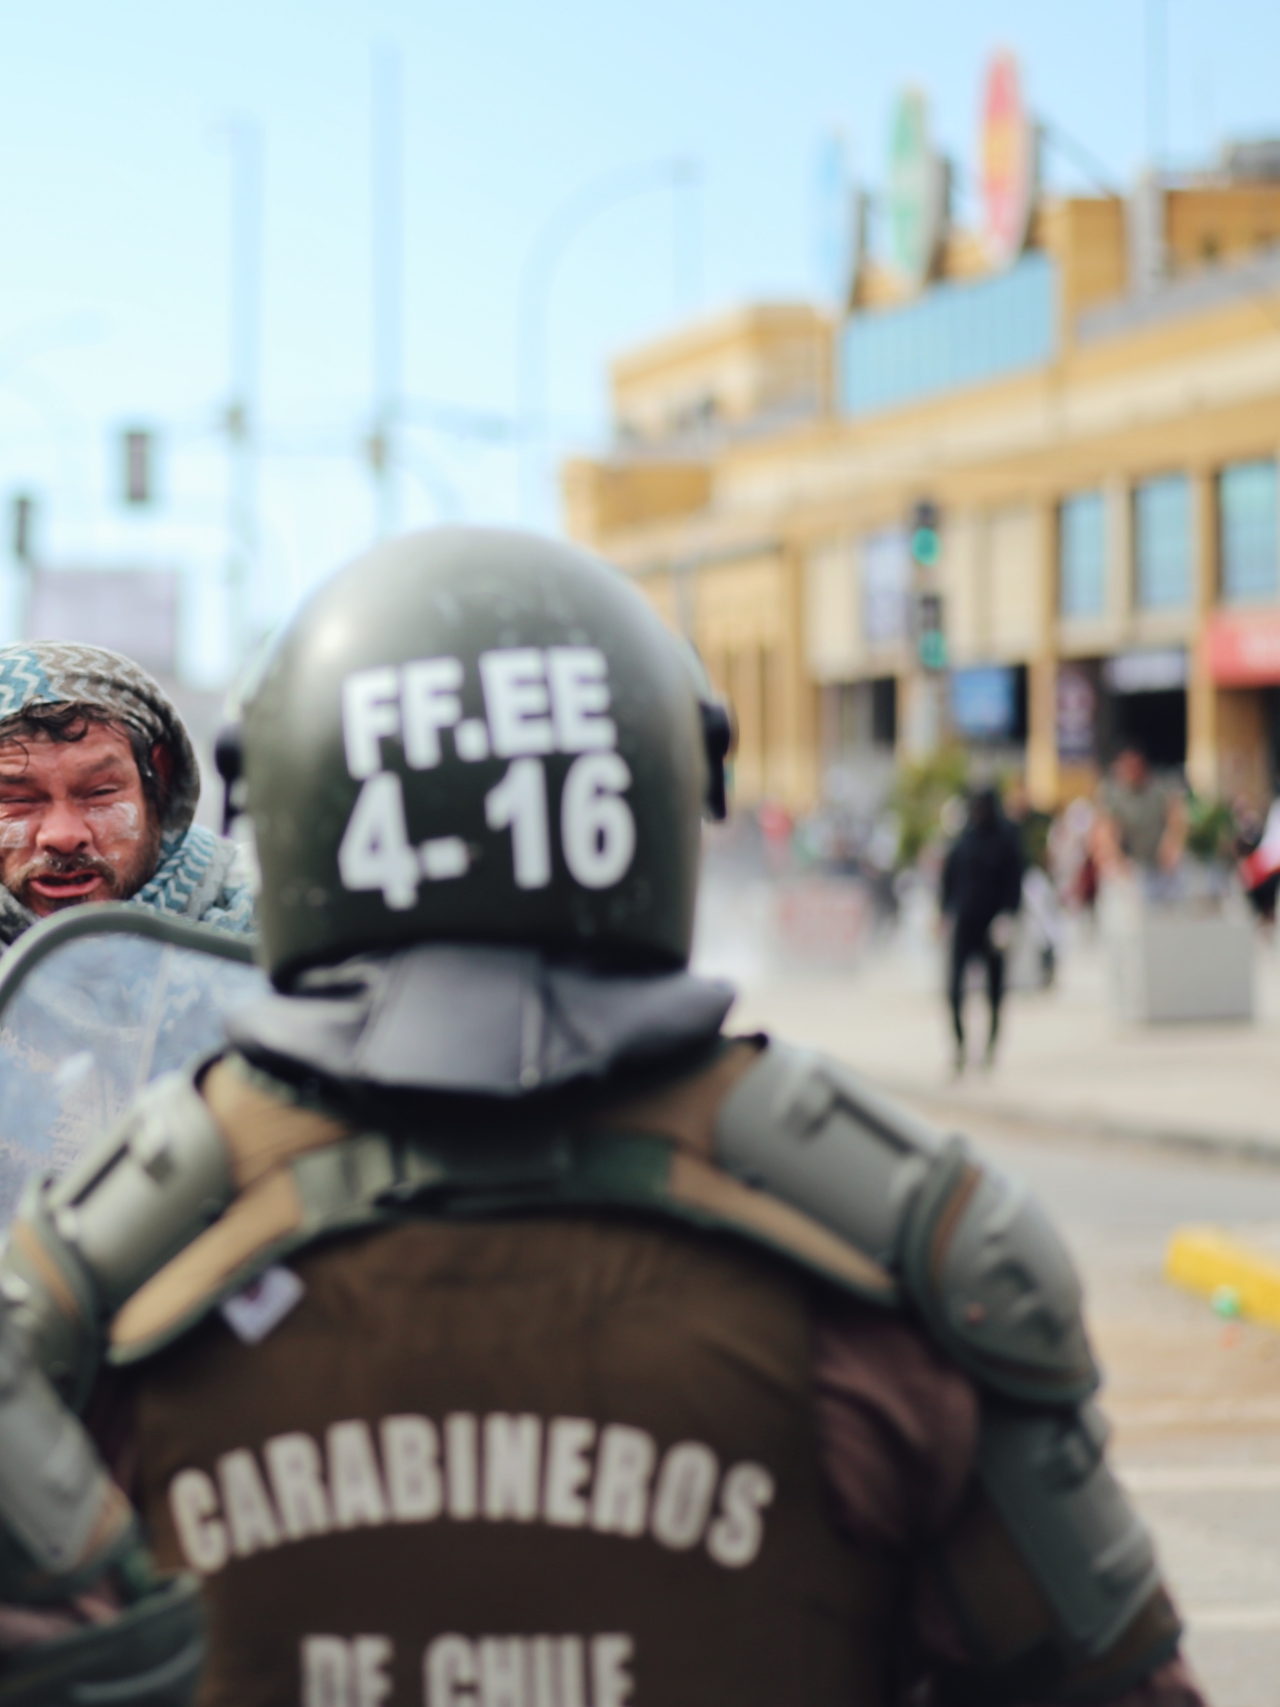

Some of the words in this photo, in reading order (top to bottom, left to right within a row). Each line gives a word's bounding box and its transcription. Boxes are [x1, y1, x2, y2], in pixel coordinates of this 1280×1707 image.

[340, 646, 618, 781] FF.EE
[337, 750, 637, 910] 4-16
[168, 1410, 775, 1573] CARABINEROS
[301, 1634, 394, 1707] DE
[424, 1633, 635, 1707] CHILE
